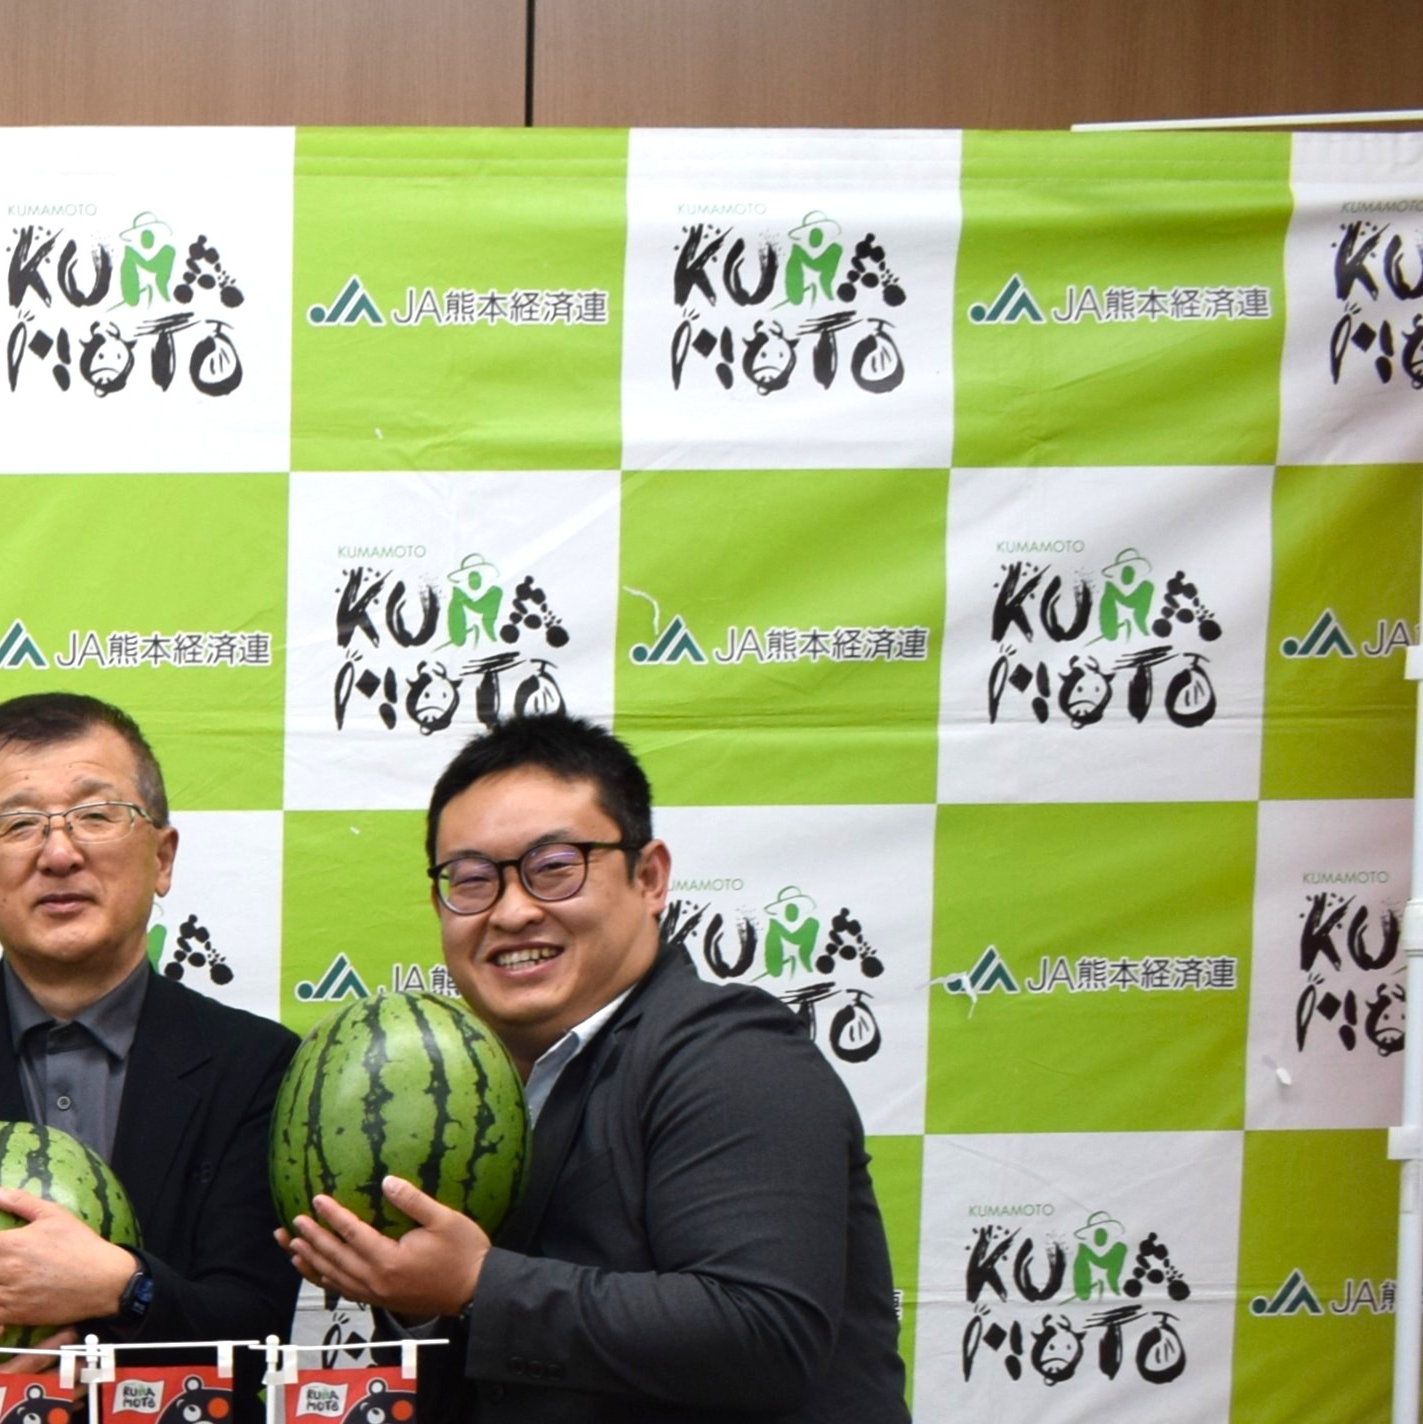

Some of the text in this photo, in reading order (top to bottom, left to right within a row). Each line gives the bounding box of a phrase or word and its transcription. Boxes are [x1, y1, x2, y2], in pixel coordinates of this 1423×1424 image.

[8, 204, 97, 216] KUMAMOTO
[677, 203, 766, 215] KUMAMOTO
[8, 211, 244, 311] KUMA
[674, 211, 907, 309] KUMA
[1331, 221, 1423, 301] KU
[392, 291, 604, 325] JA熊本経済連
[1053, 289, 1270, 317] JA熊本経済連
[7, 313, 245, 397] MOTO
[670, 309, 906, 395] MOTO
[337, 546, 426, 557] KUMAMOTO
[996, 542, 1084, 553] KUMAMOTO
[337, 553, 570, 652] KUMA
[992, 548, 1222, 645] KUMA
[57, 634, 268, 666] JA熊本経済連
[715, 629, 926, 661] JA熊本経済連
[990, 646, 1218, 729] MOTO
[1303, 874, 1389, 884] KUMAMOTO
[1300, 893, 1401, 973] KU
[1030, 959, 1234, 991] JA熊本経済連
[1296, 973, 1406, 1056] MO
[767, 981, 881, 1063] TO
[968, 1204, 1053, 1217] KUMAMOTO
[966, 1211, 1190, 1307] KUMA
[963, 1305, 1187, 1387] MOTO
